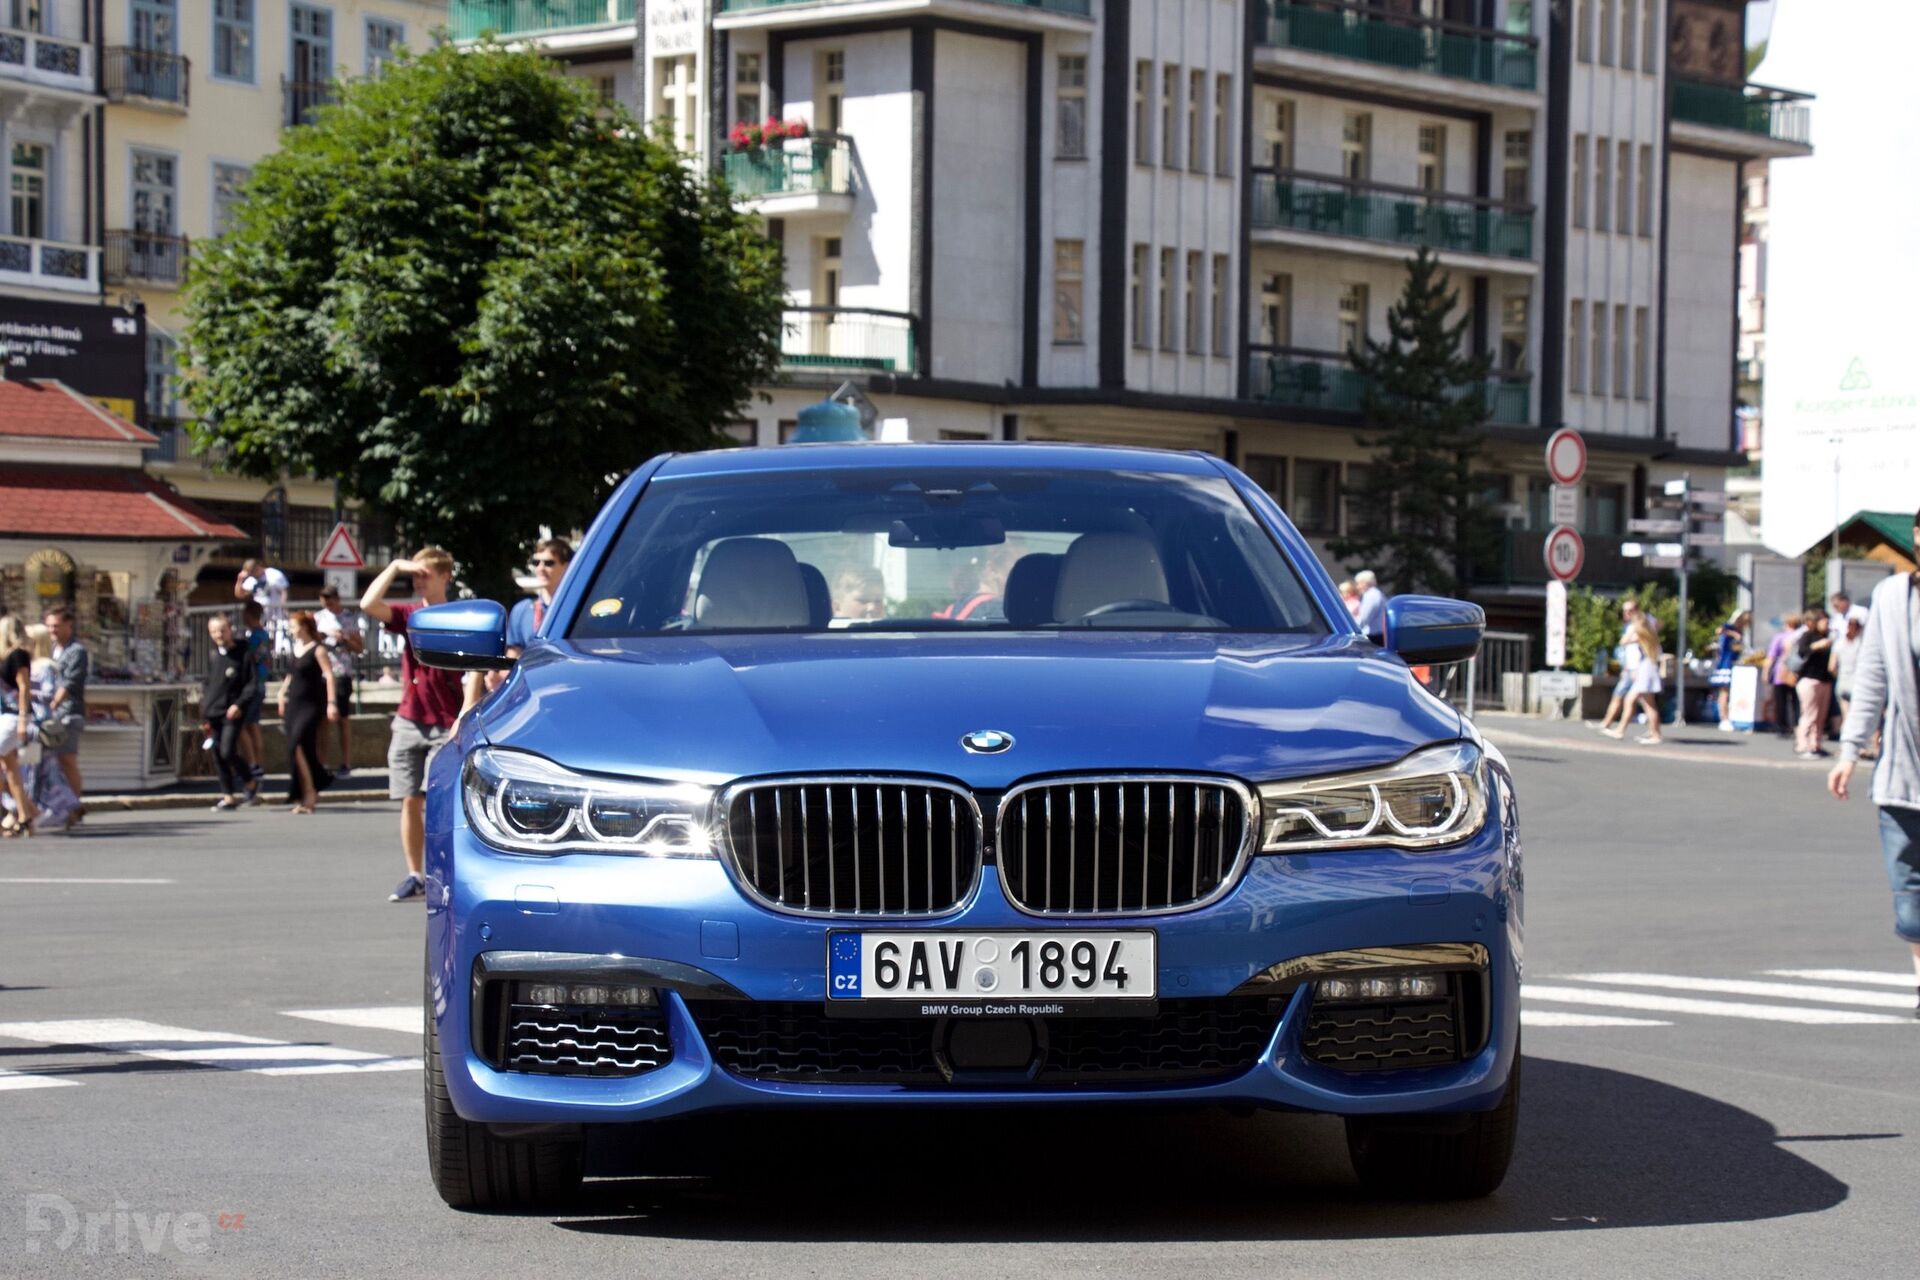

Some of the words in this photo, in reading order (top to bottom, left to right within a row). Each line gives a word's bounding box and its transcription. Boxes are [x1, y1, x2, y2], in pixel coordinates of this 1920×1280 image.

[834, 974, 857, 990] CZ
[873, 940, 964, 990] 6AV
[1010, 940, 1128, 990] 1894
[921, 1005, 948, 1015] BMW
[950, 1004, 983, 1016] Group
[985, 1004, 1017, 1015] Czech
[1018, 1004, 1064, 1016] Republic
